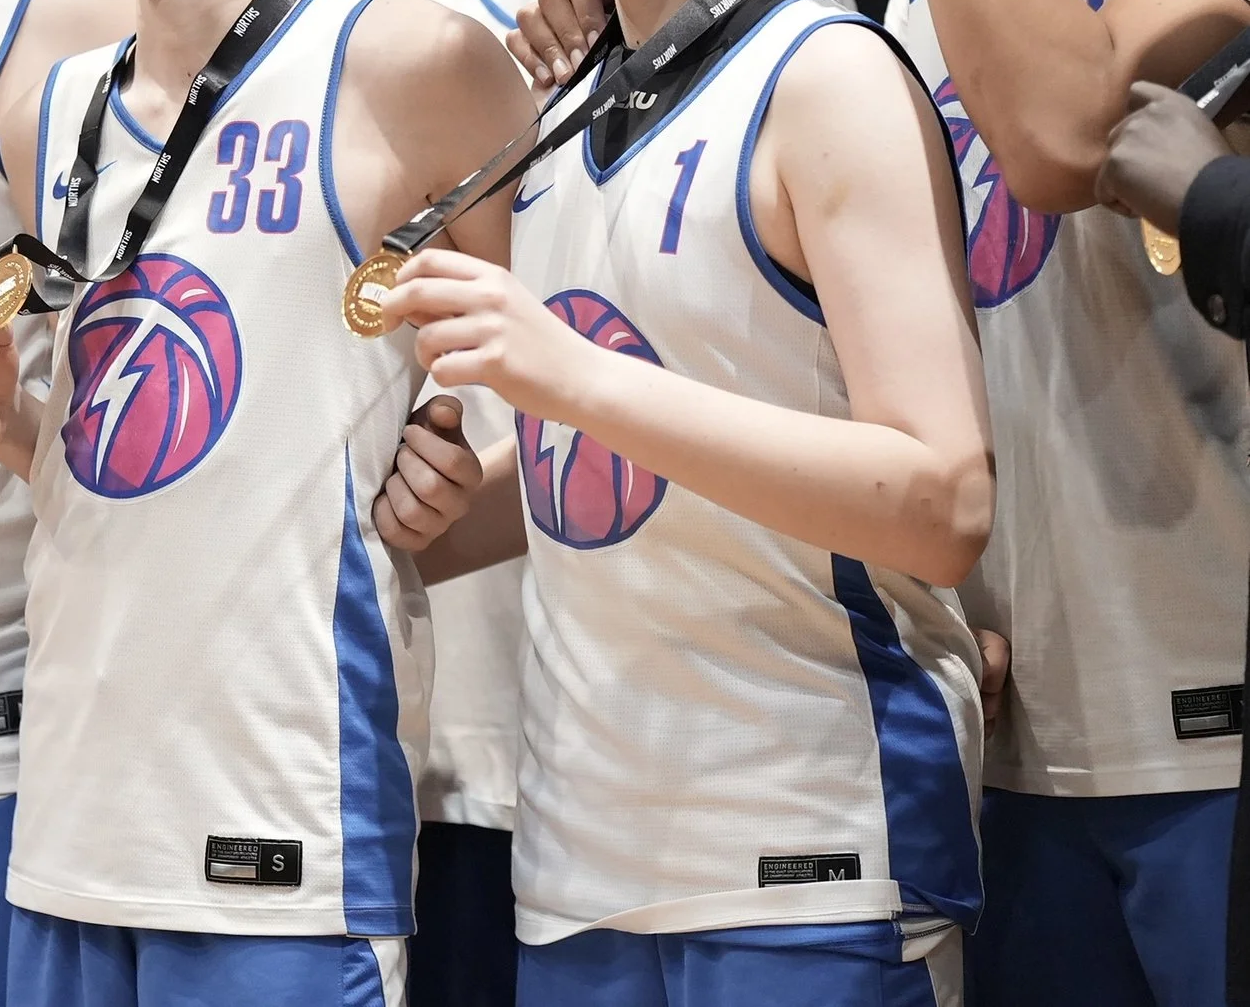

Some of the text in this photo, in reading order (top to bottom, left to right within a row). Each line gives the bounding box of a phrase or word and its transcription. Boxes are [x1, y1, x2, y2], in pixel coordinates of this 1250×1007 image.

[233, 6, 260, 38] NORTHS
[652, 43, 678, 70] NORTHS
[188, 74, 207, 106] NORTHS
[592, 94, 616, 120] NORTHS
[152, 152, 172, 184] NORTHS
[206, 119, 310, 234] 33
[68, 177, 81, 208] NORTHS
[659, 139, 708, 255] 1
[116, 229, 133, 260] NORTHS
[211, 842, 259, 852] ENGINEERED
[271, 854, 285, 873] S
[763, 862, 814, 870] ENGINEERED
[828, 868, 845, 881] M
